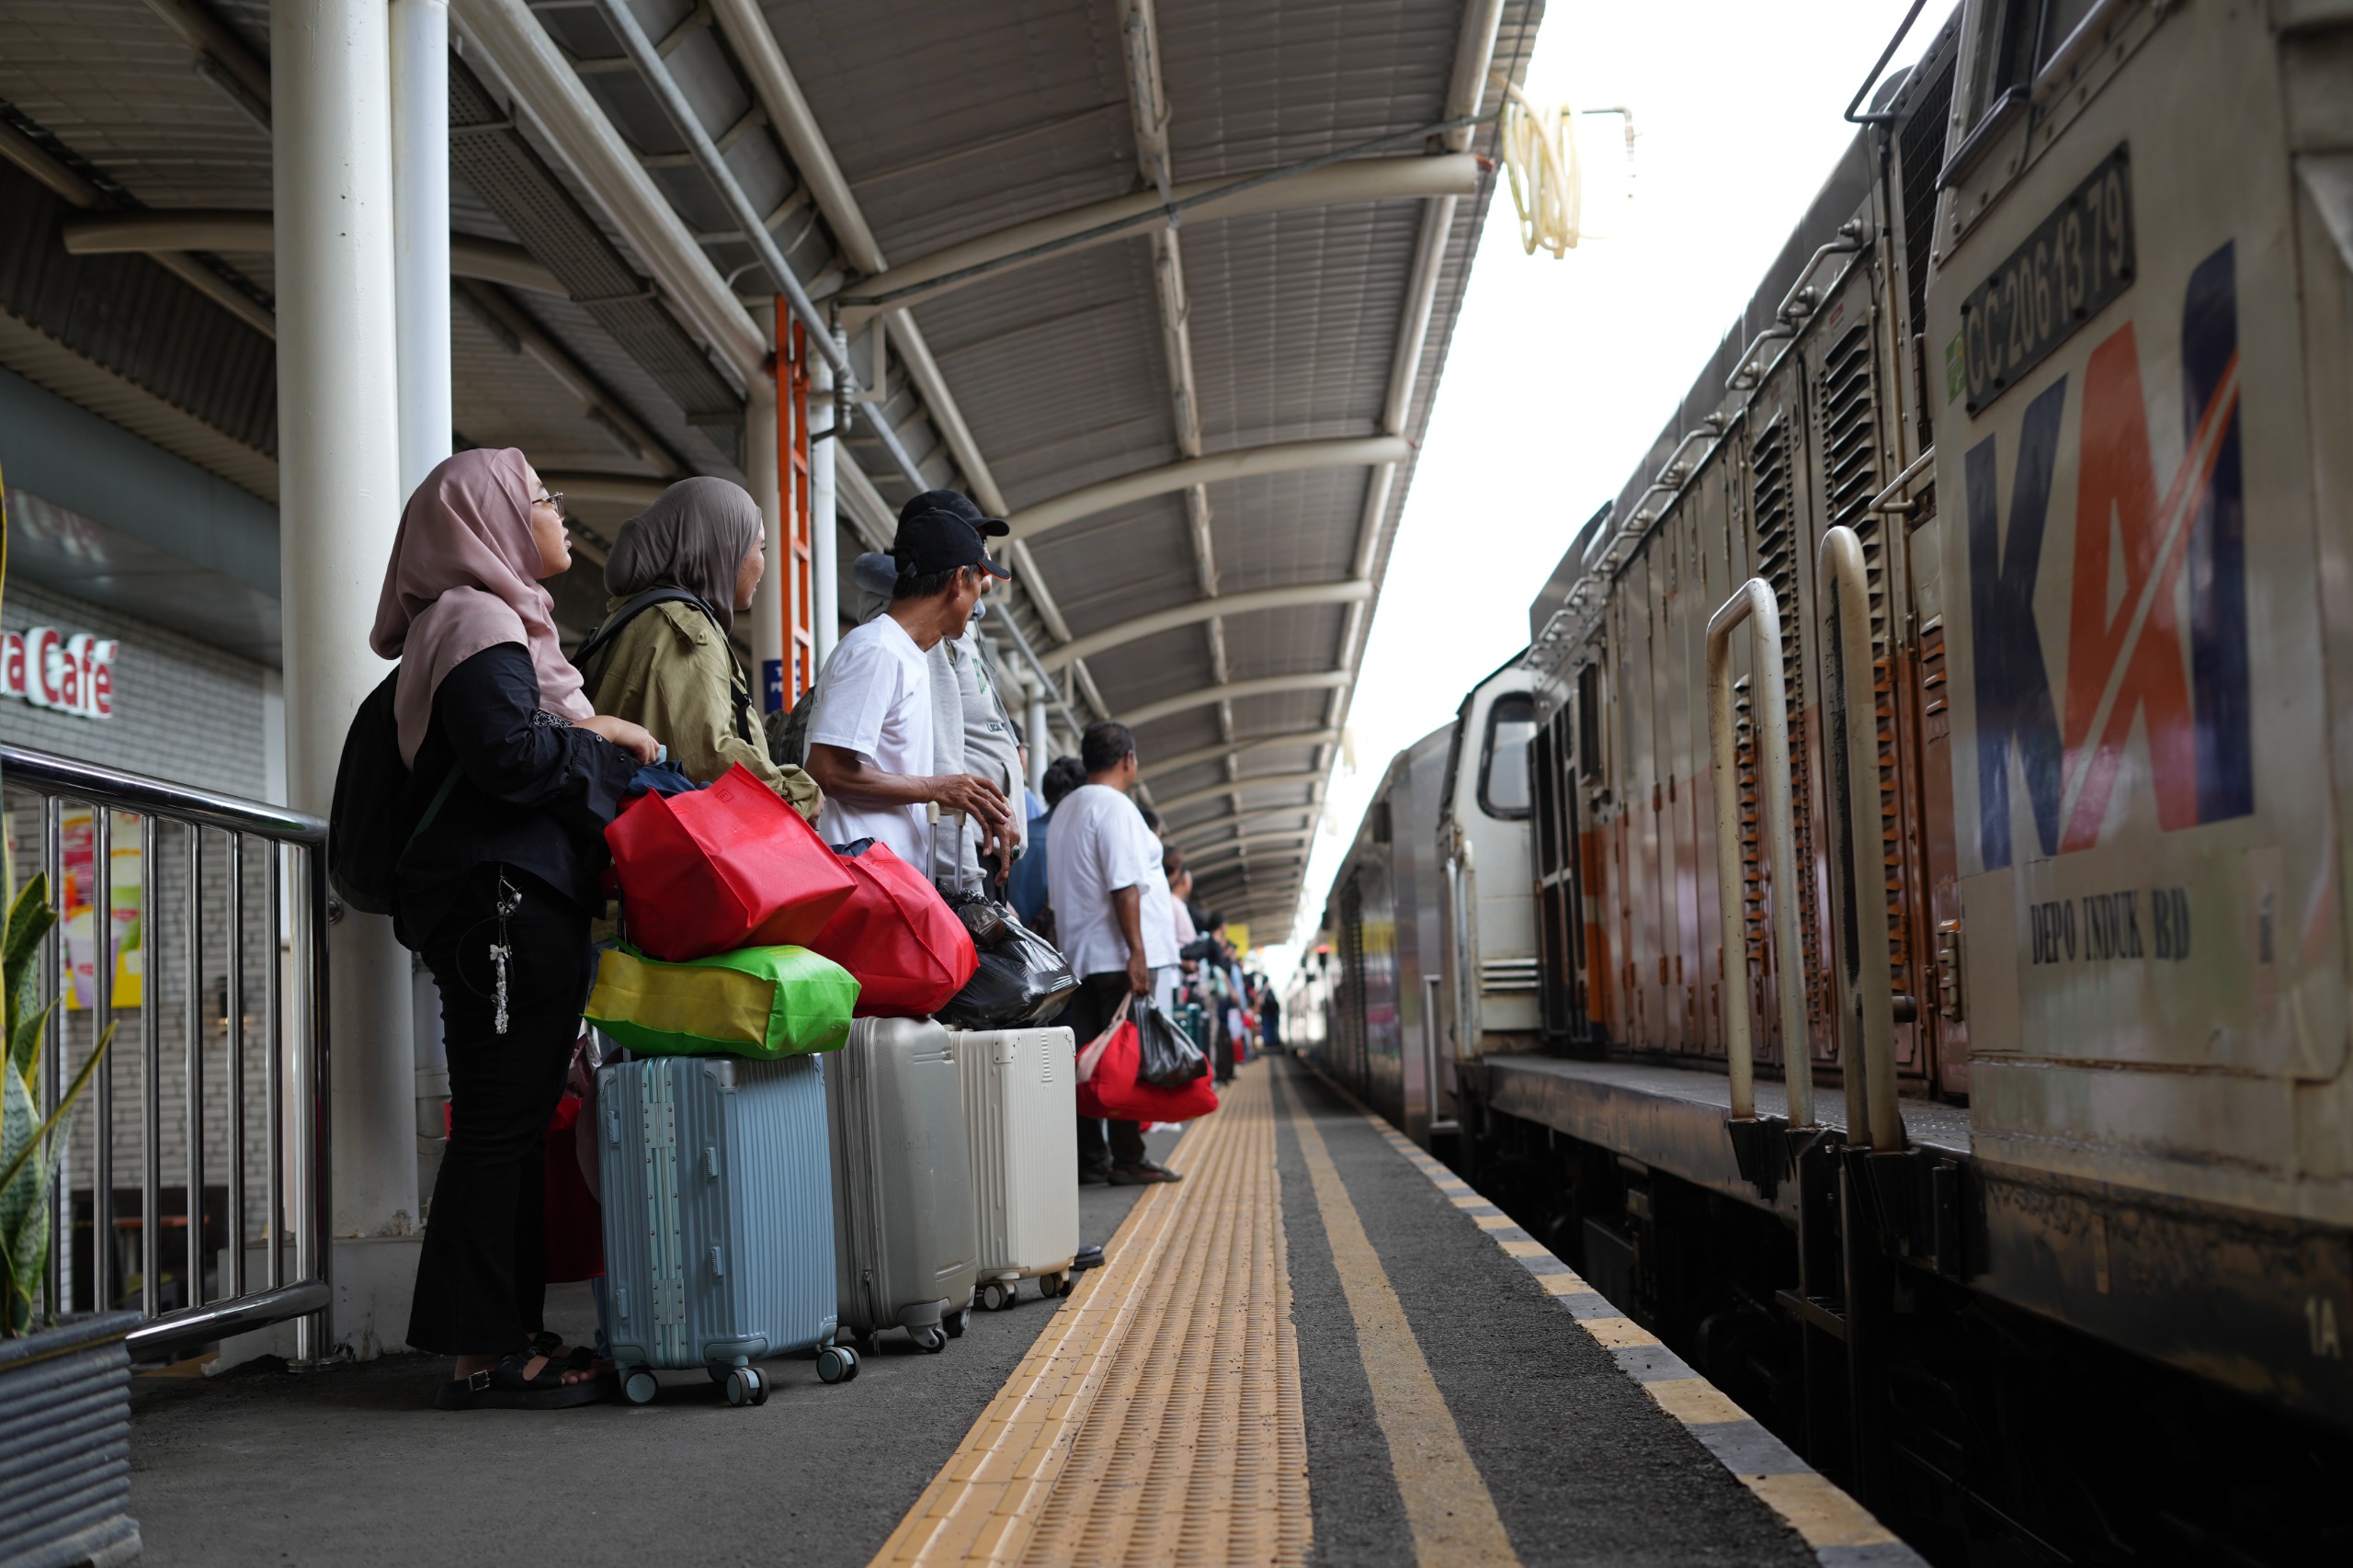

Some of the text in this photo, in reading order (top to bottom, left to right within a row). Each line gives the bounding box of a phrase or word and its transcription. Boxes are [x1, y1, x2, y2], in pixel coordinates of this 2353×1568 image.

[1967, 287, 2003, 397] CC
[1965, 237, 2256, 872] KAI
[0, 628, 118, 717] a Café
[2029, 898, 2076, 965] DEPO
[2082, 889, 2145, 961] INDUK
[2152, 887, 2191, 961] BD
[2303, 1294, 2343, 1361] 1A
